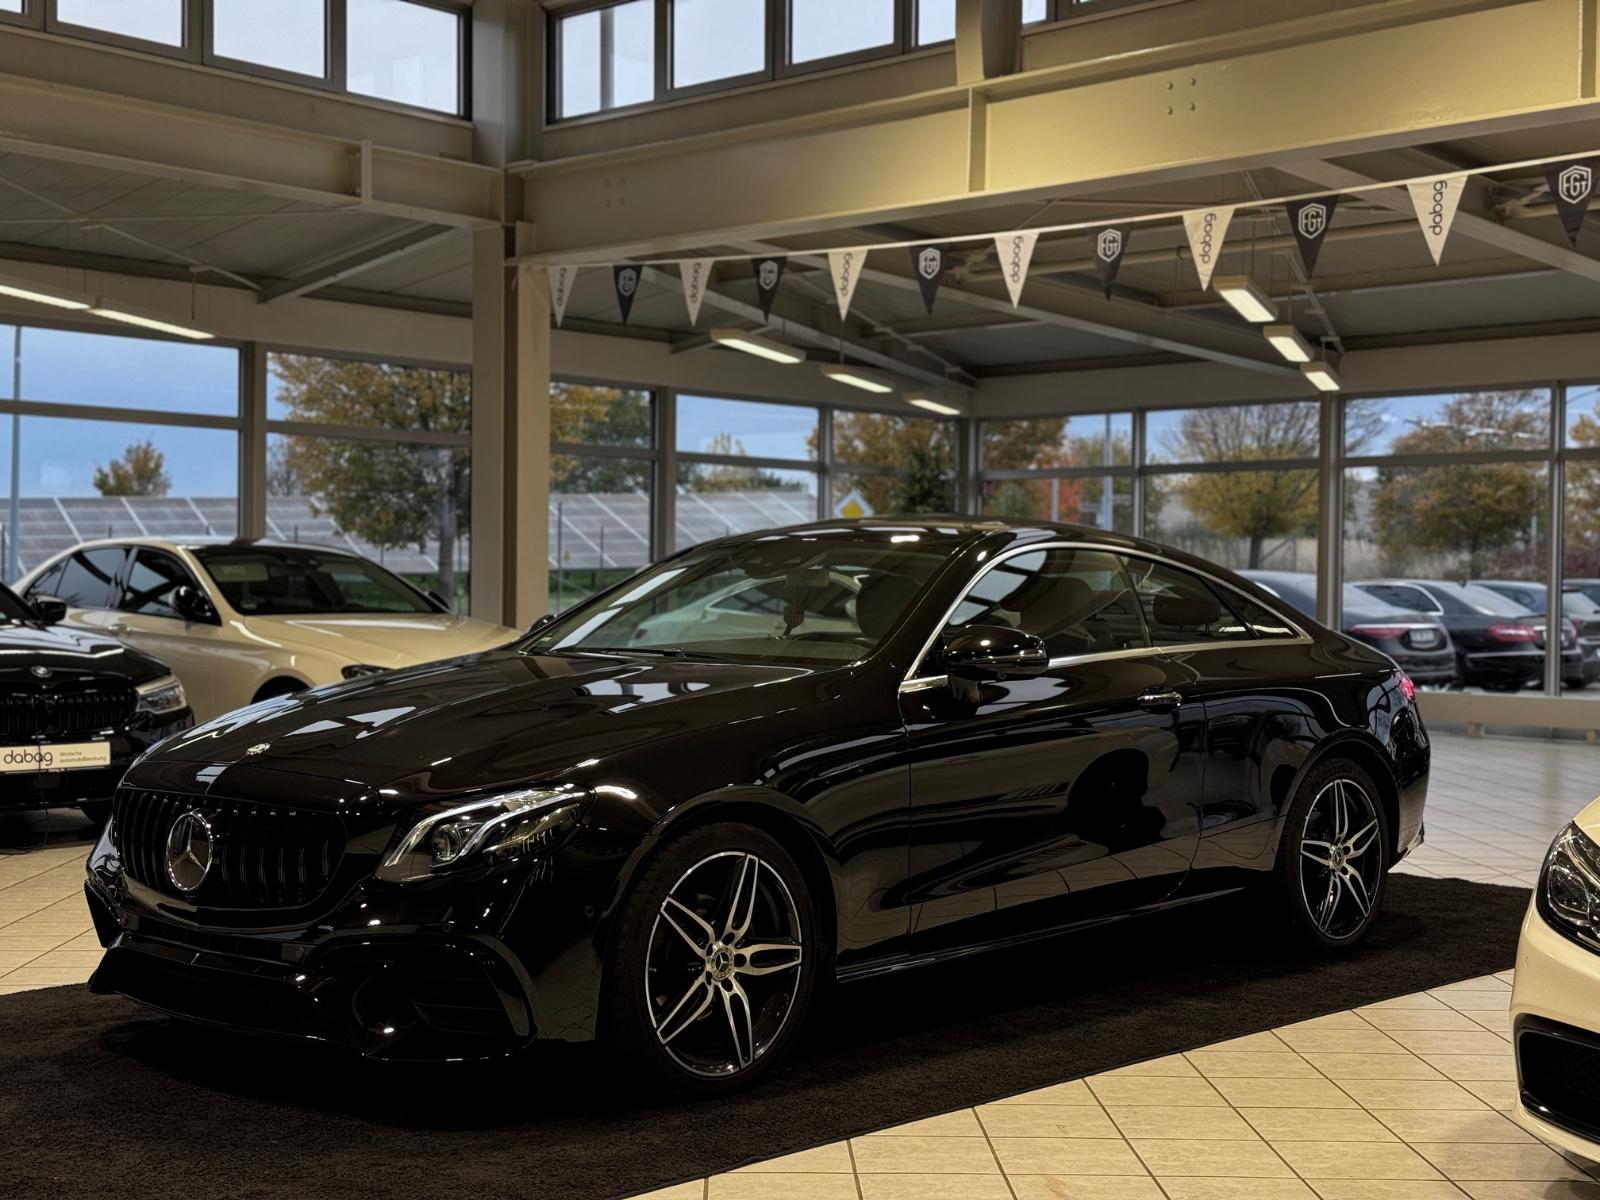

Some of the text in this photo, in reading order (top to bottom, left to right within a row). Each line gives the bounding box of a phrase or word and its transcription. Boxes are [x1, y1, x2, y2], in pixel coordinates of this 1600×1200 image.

[1428, 180, 1448, 236] dabag
[1010, 235, 1025, 284] dabag
[1199, 212, 1217, 265] dabag
[689, 262, 701, 304] dabag
[839, 252, 853, 297] dabag
[3, 749, 53, 767] dabag
